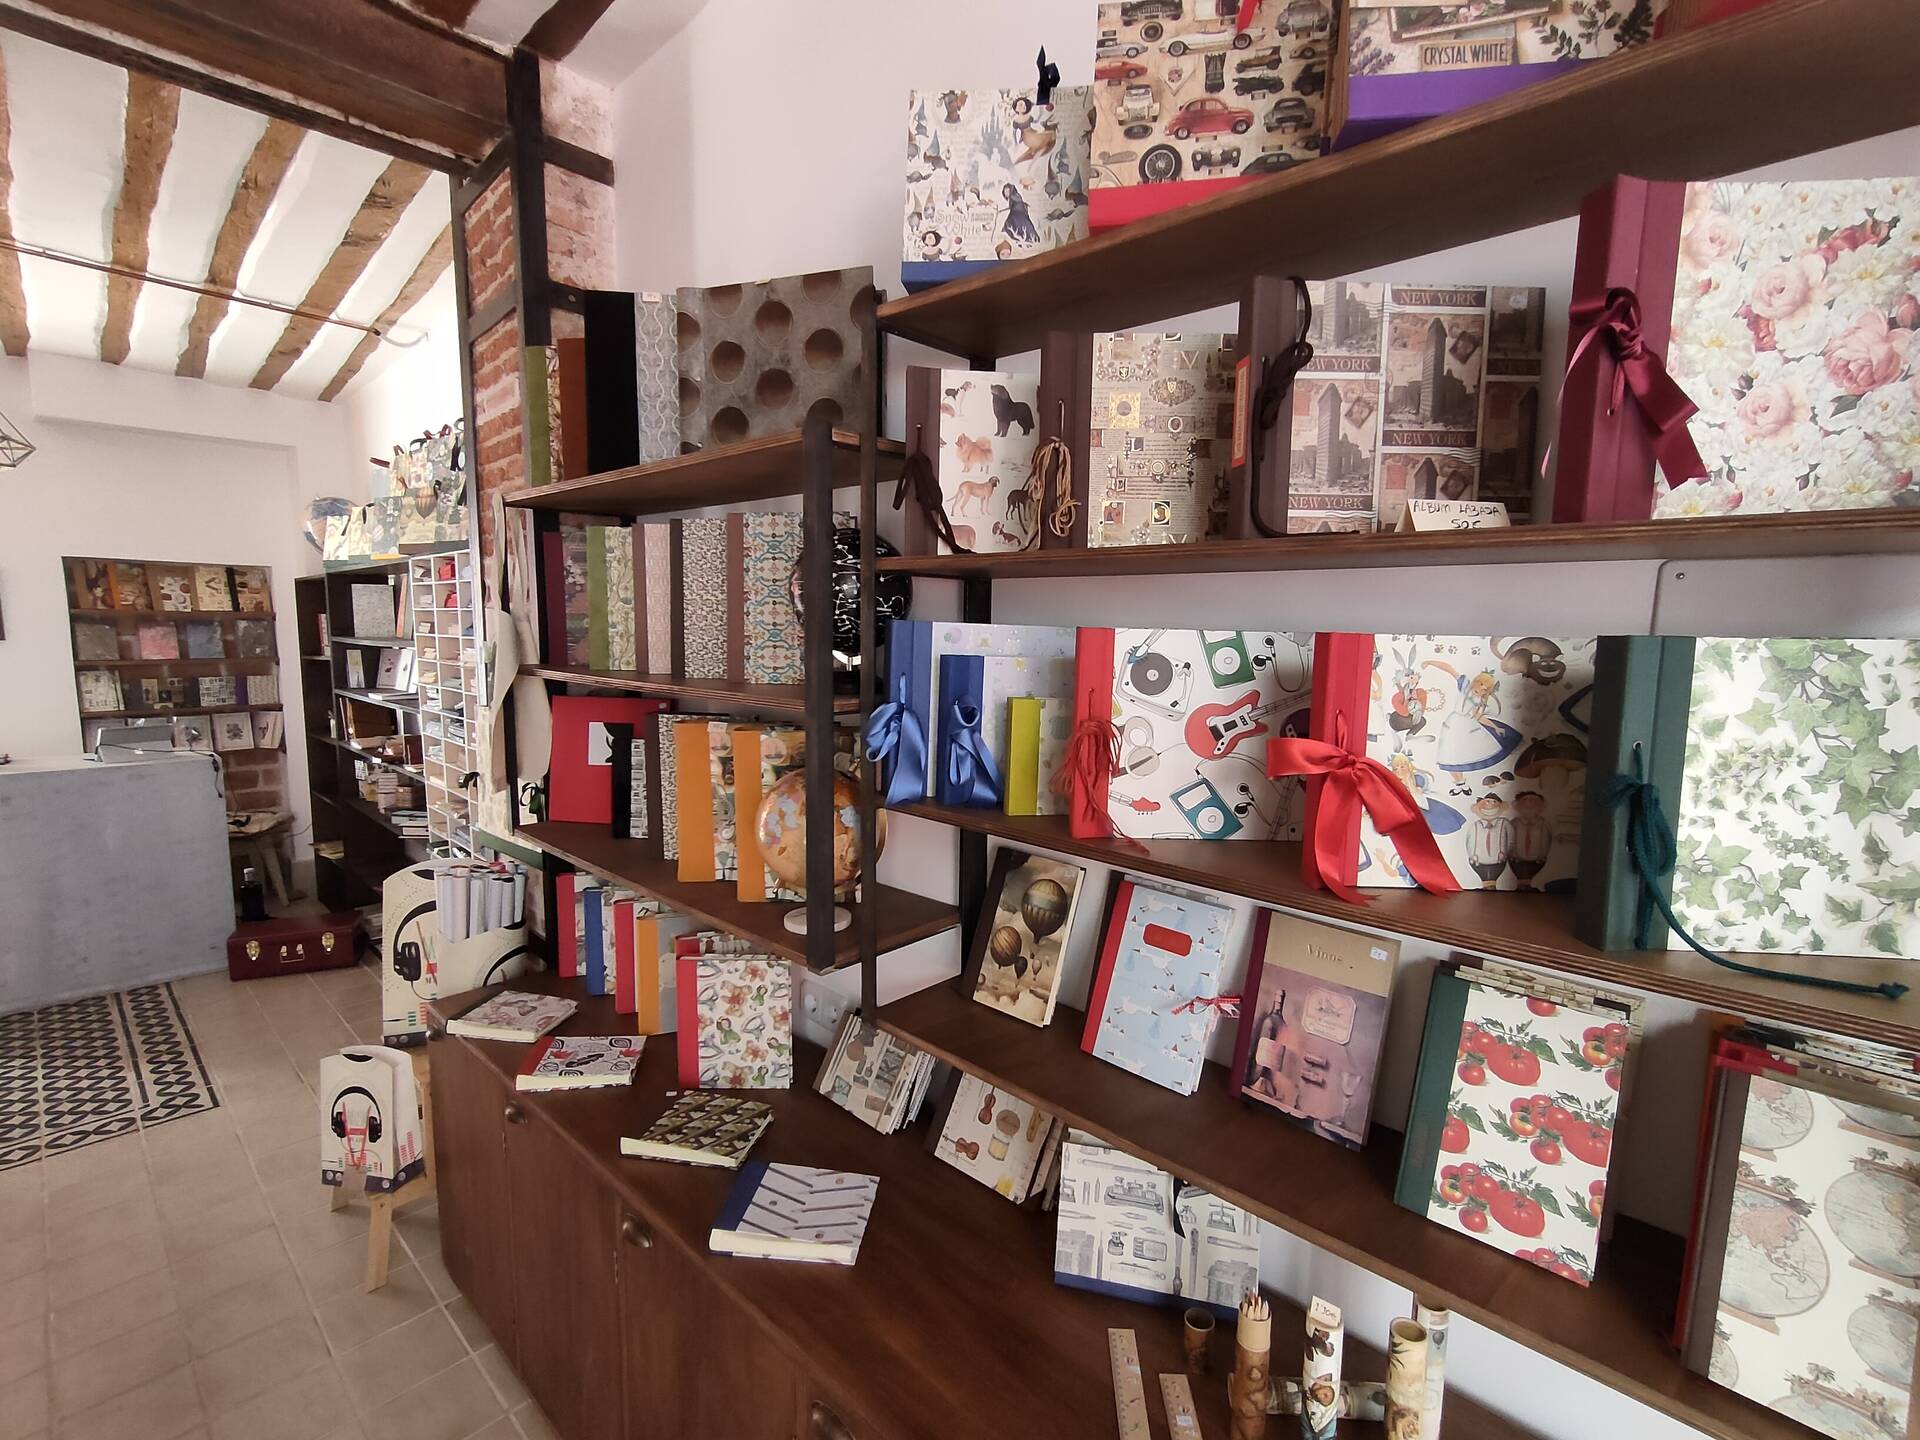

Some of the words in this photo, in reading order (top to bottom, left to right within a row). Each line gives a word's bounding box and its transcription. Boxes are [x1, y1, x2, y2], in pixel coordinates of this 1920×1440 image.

[1424, 46, 1468, 65] CRYSTAL
[1471, 43, 1507, 63] WHITE
[1400, 291, 1433, 305] NEW
[1437, 291, 1477, 306] YORK
[1304, 358, 1329, 371] EW
[1331, 358, 1371, 371] YORK
[1391, 433, 1425, 446] NEW
[1428, 433, 1467, 446] YORK
[1288, 496, 1325, 509] NEW
[1326, 496, 1365, 509] YORK
